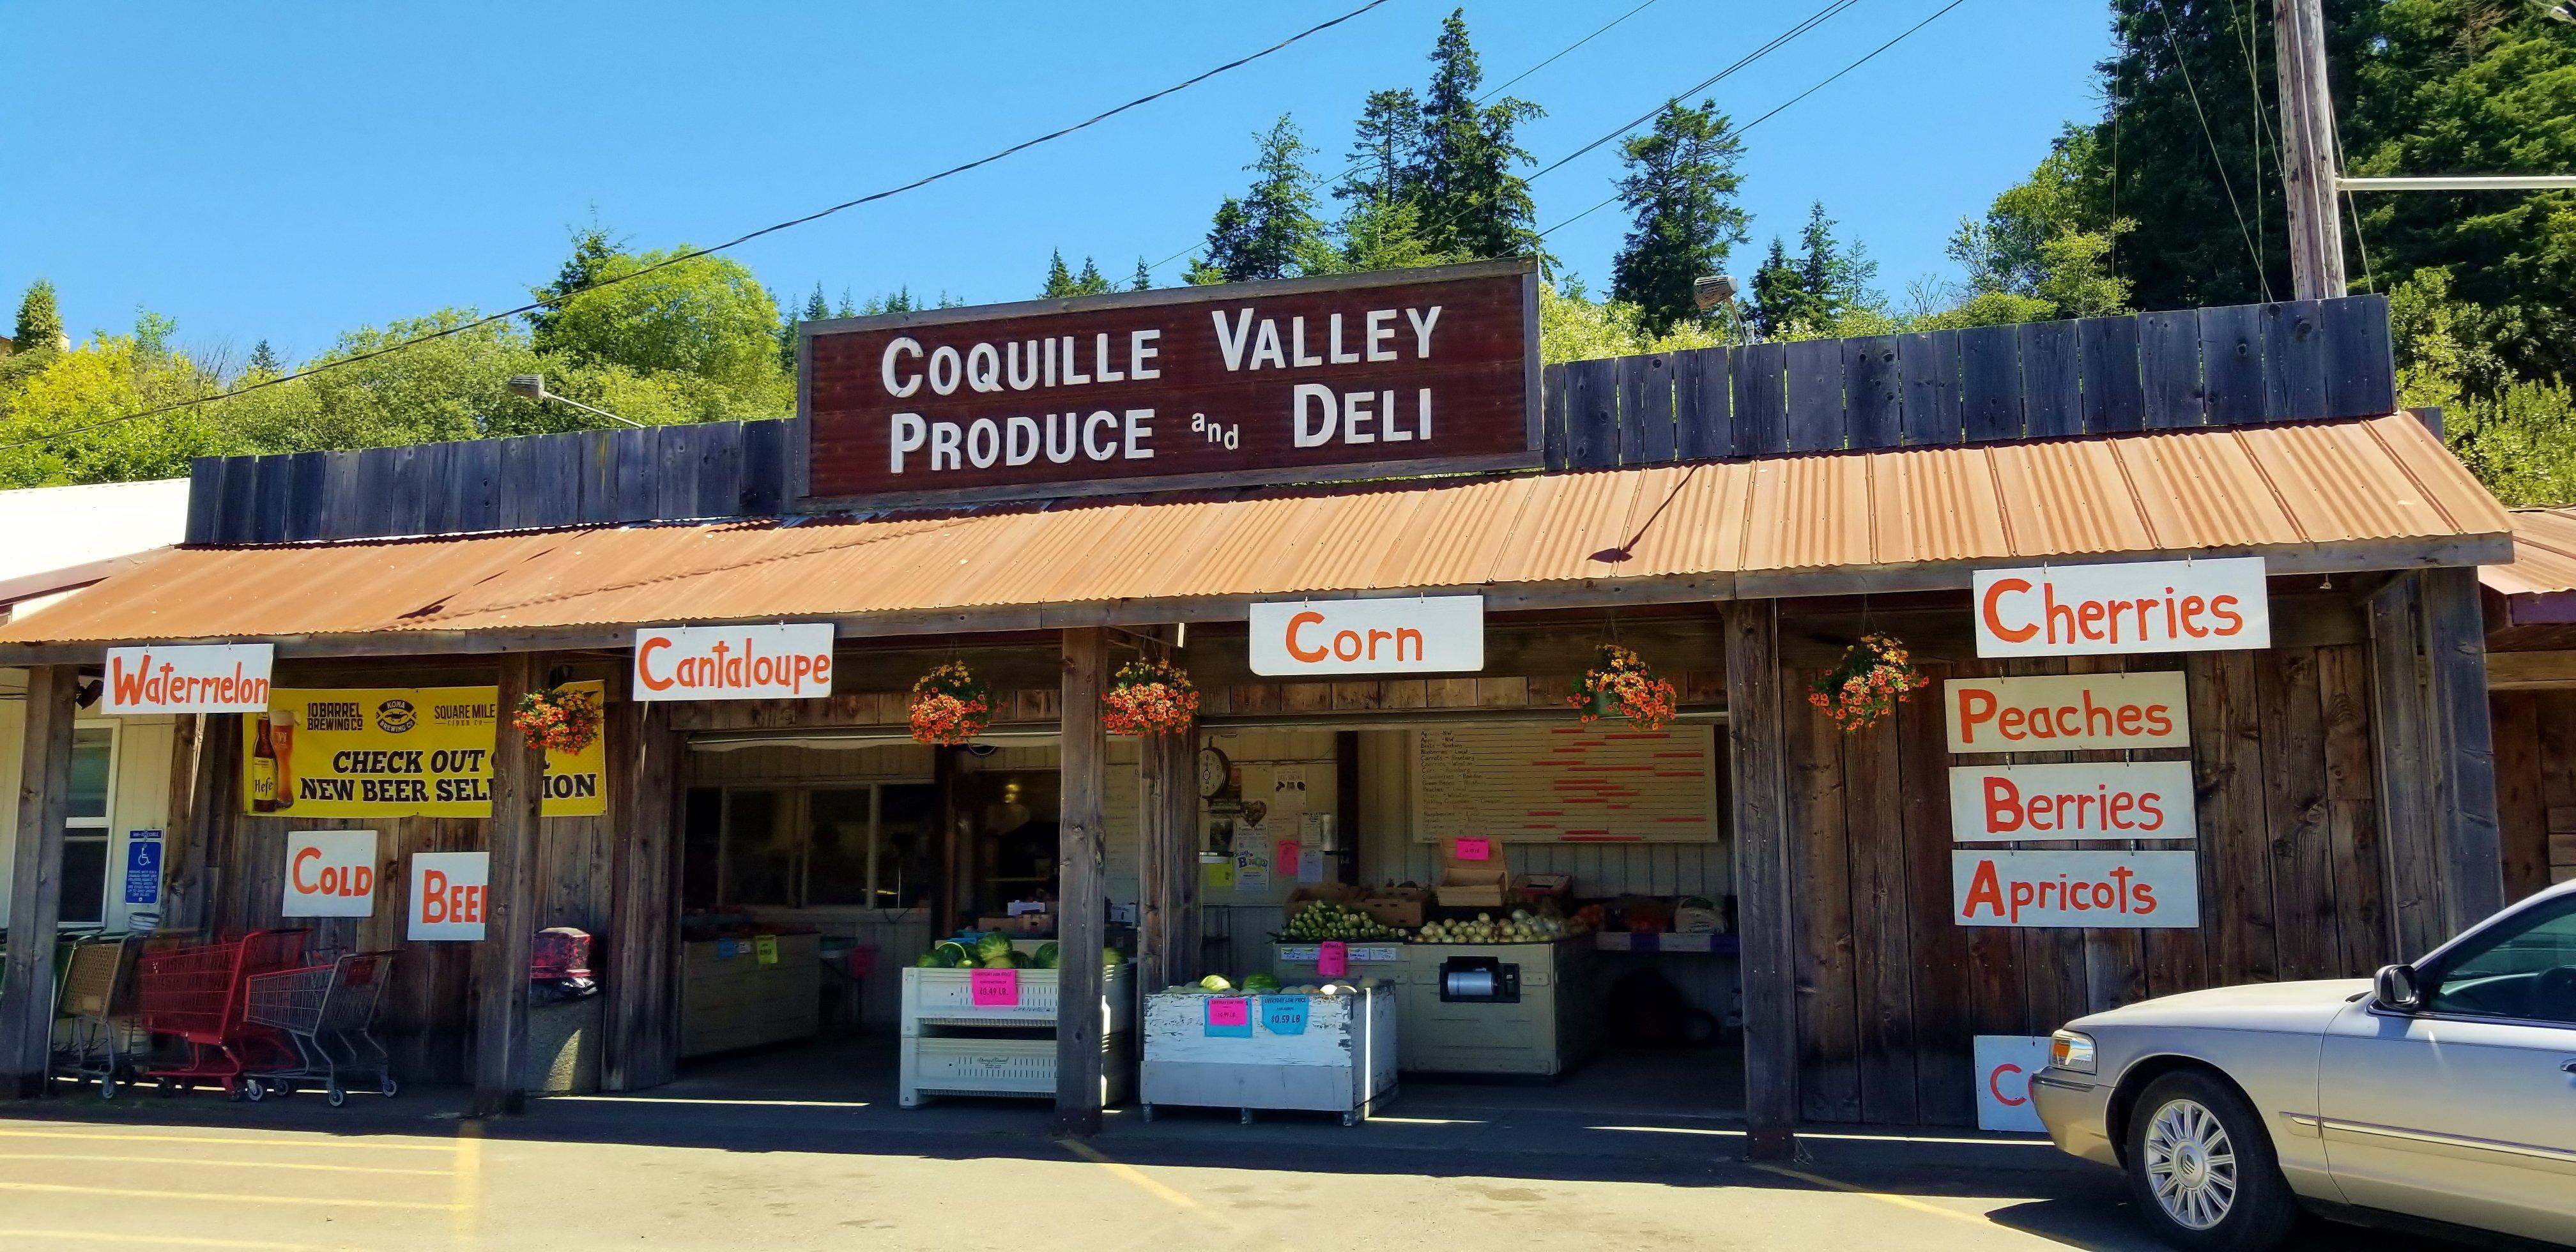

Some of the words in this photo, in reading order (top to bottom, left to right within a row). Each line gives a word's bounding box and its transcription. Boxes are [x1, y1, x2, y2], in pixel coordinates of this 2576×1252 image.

[882, 330, 1161, 397] COQUILLE
[1212, 306, 1441, 371] VALLEY
[891, 409, 1155, 473] PRODUCE
[1192, 412, 1238, 450] and
[1294, 384, 1431, 448] DELI
[1984, 578, 2242, 645] Cherries
[1285, 611, 1423, 663] Corn
[113, 655, 269, 706] Watermelon
[639, 637, 831, 694] Cantaloupe
[307, 717, 349, 731] BREWING
[379, 721, 406, 732] BREWING
[387, 701, 405, 709] KONA
[434, 705, 471, 719] SQUARE
[472, 703, 496, 718] MILE
[1958, 688, 2173, 744] Peaches
[332, 750, 424, 774] CHECK
[430, 749, 486, 774] OUT
[254, 776, 273, 798] Hefe
[300, 777, 355, 800] NEW
[361, 779, 430, 802] BEER
[435, 774, 597, 802] SELION
[1984, 776, 2163, 833] Berries
[294, 848, 373, 896] COLD
[1964, 860, 2157, 924] Apricots
[1271, 1014, 1289, 1023] $0.59
[1292, 1014, 1301, 1023] LB
